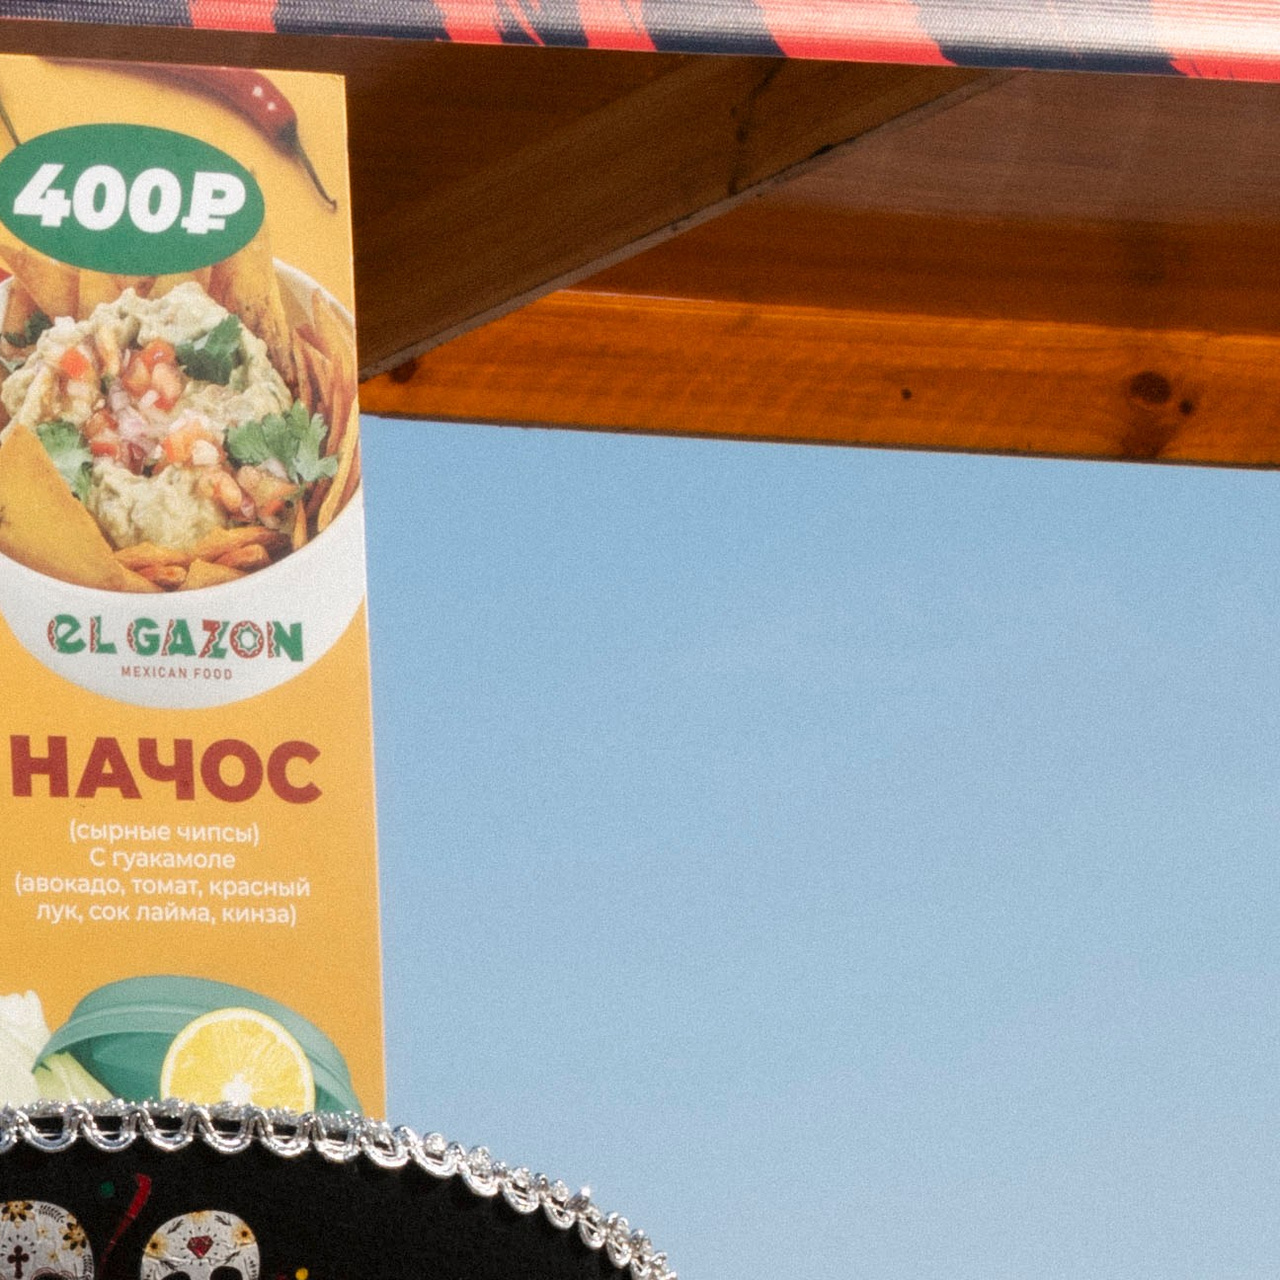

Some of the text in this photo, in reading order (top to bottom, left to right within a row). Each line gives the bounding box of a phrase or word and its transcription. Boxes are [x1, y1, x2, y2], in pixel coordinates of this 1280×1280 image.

[126, 617, 304, 662] GAZON
[120, 665, 233, 680] MEXICAN FOOD
[10, 735, 322, 804] НАЧОС
[69, 818, 260, 848] (сырные чипсы)
[88, 845, 237, 873] С гуакамоле
[14, 870, 312, 901] (авокадо, томат, красный
[36, 900, 298, 928] лук, сок лайма, кинза)
